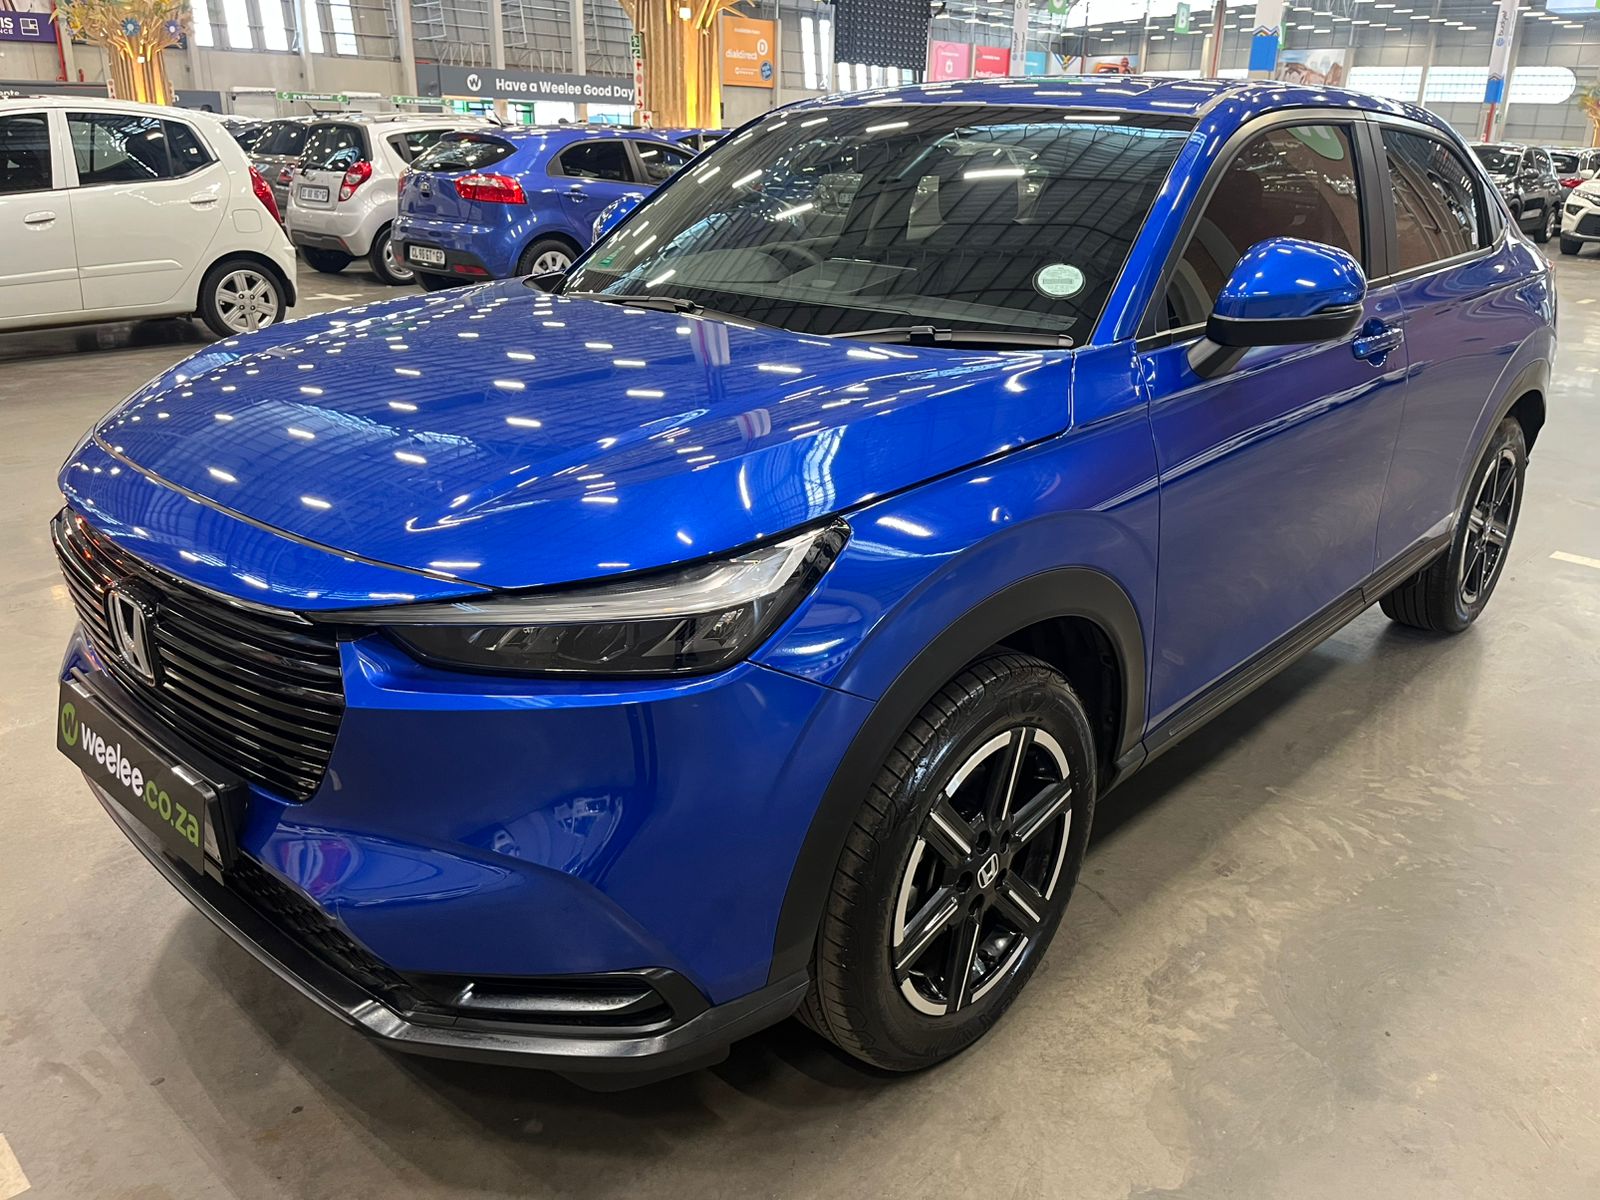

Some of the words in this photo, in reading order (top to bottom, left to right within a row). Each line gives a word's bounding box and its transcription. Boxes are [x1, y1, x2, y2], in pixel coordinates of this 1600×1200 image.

[495, 78, 527, 91] Have
[529, 83, 538, 92] a
[539, 81, 582, 94] Weelee
[583, 84, 612, 97] Good
[613, 86, 634, 101] Day
[81, 722, 200, 847] weelee.co.za
